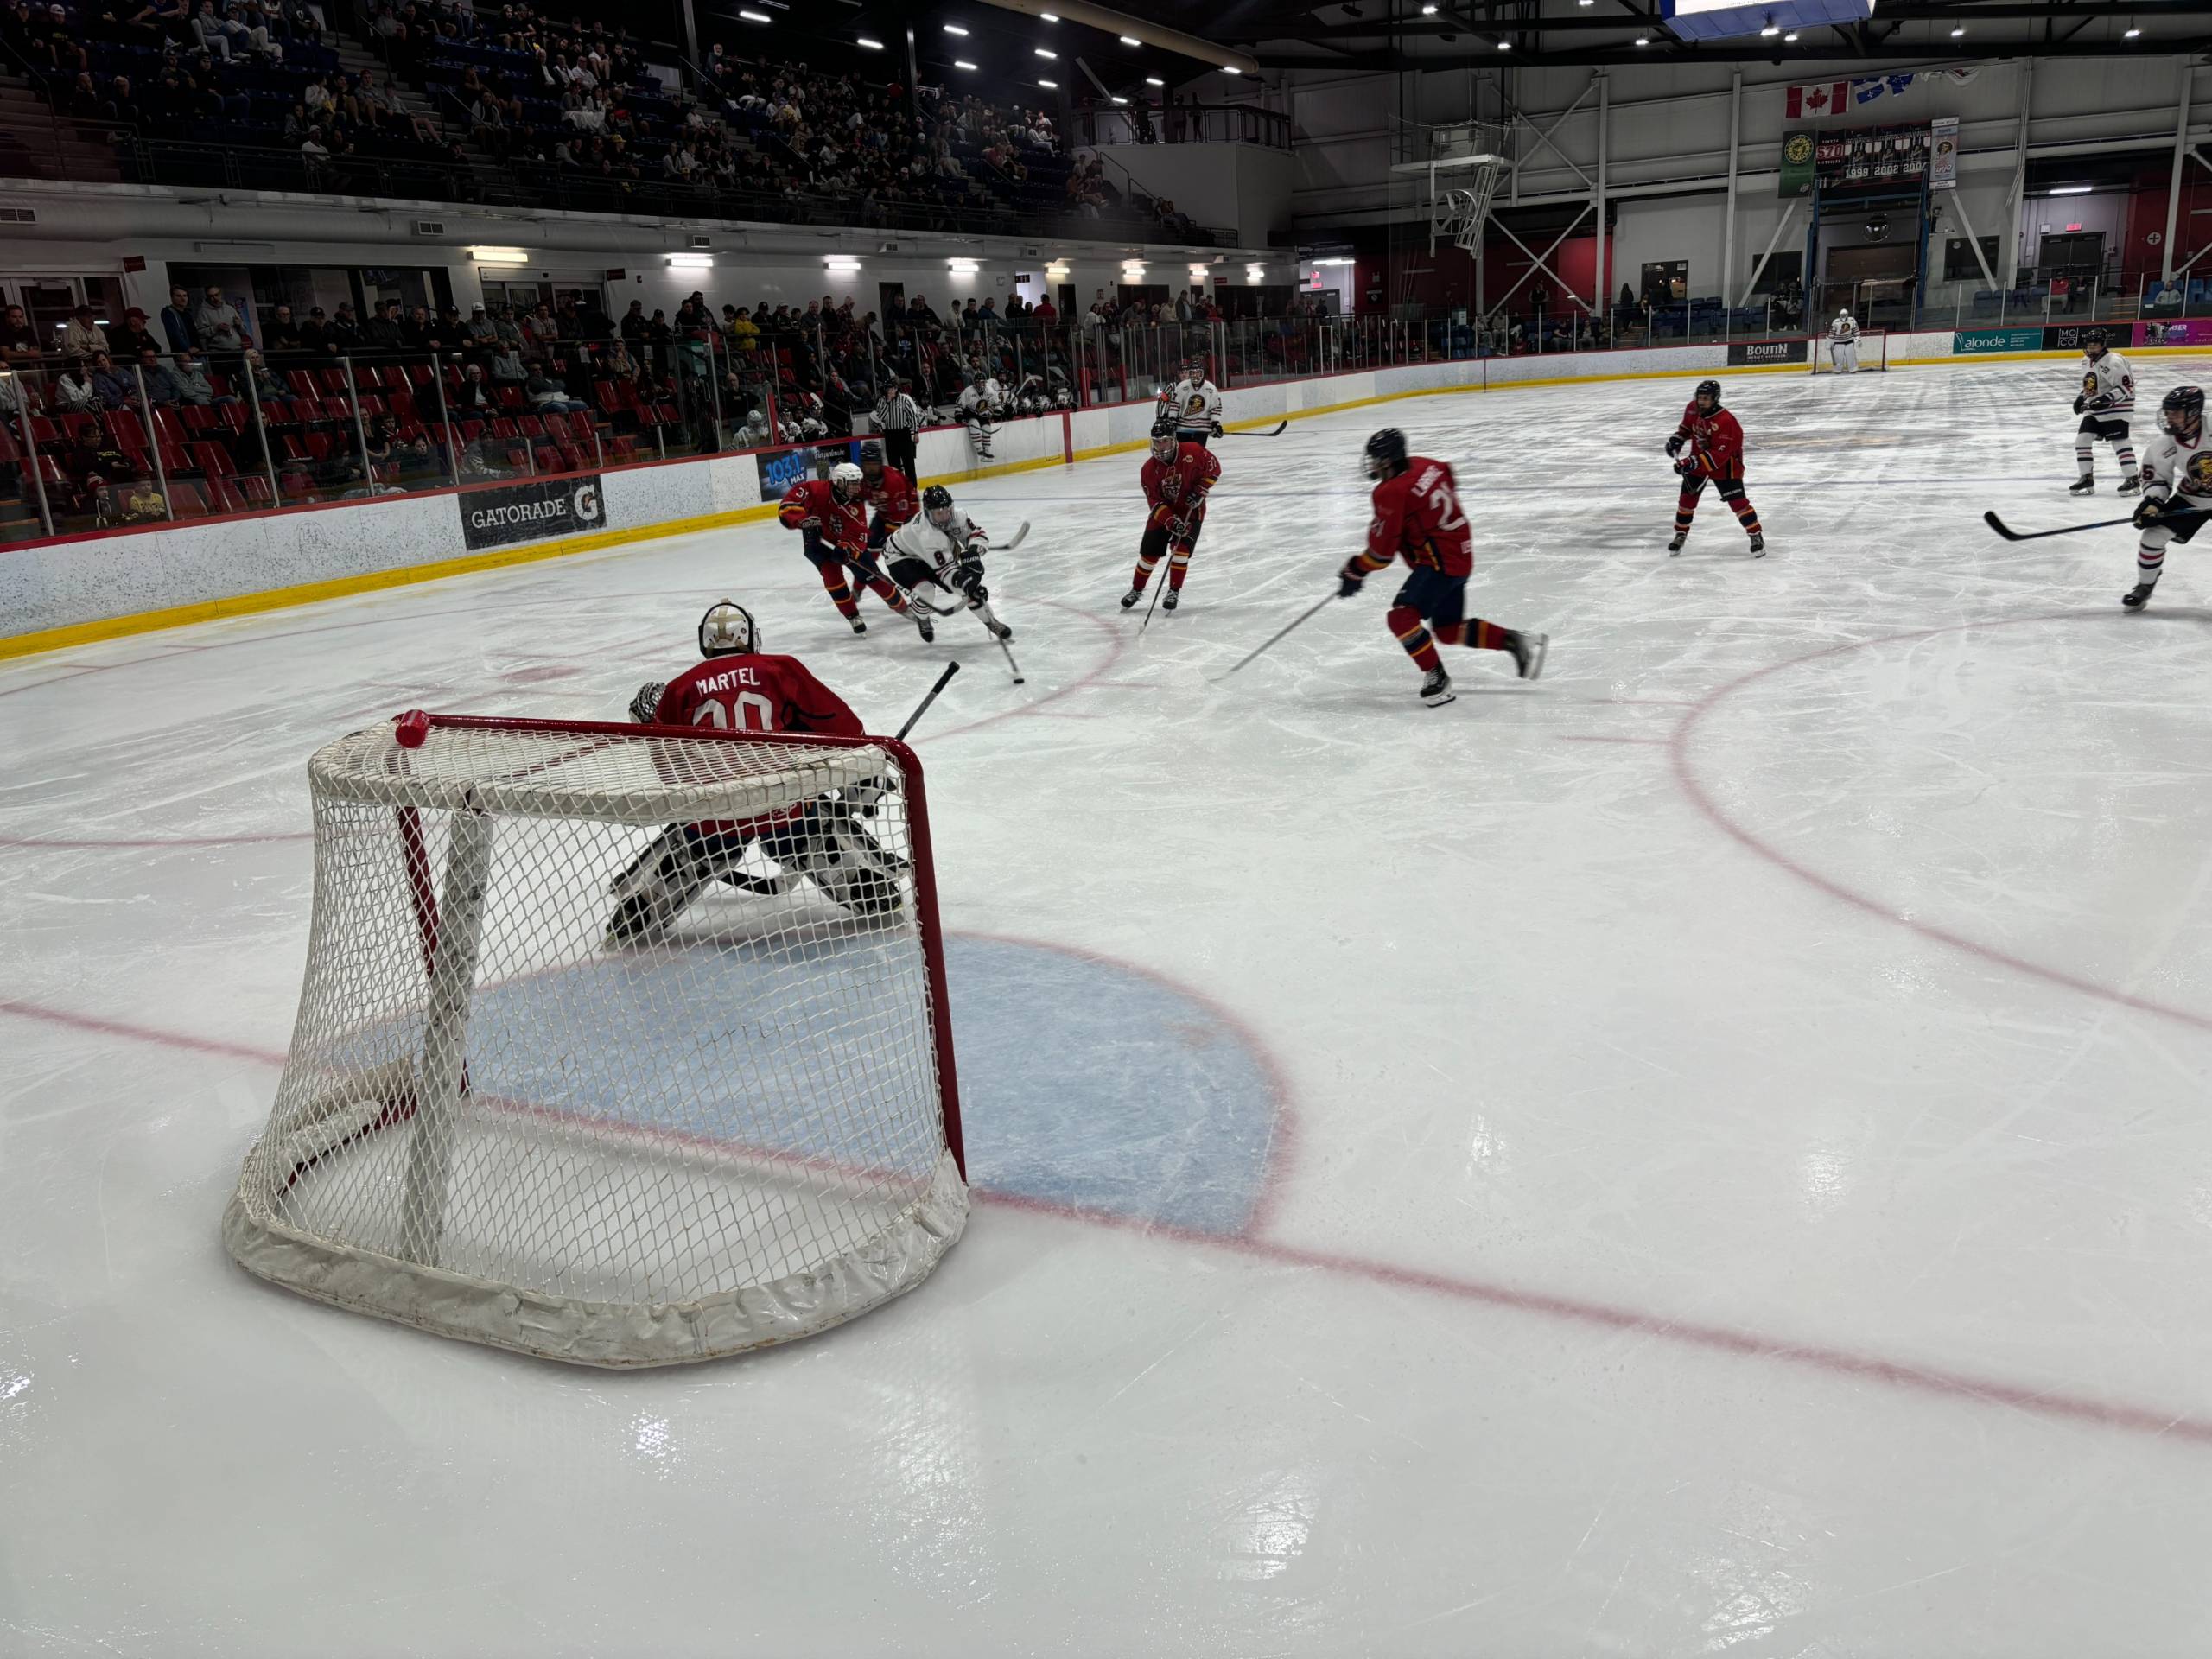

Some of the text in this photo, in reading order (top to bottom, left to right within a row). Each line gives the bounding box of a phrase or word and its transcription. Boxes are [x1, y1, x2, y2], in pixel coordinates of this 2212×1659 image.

[1816, 144, 1843, 159] 570
[1846, 168, 1869, 179] 1999
[1874, 165, 1899, 176] 2002
[790, 473, 805, 485] MAX
[471, 498, 567, 530] GATORADE
[696, 667, 761, 697] MARTEL
